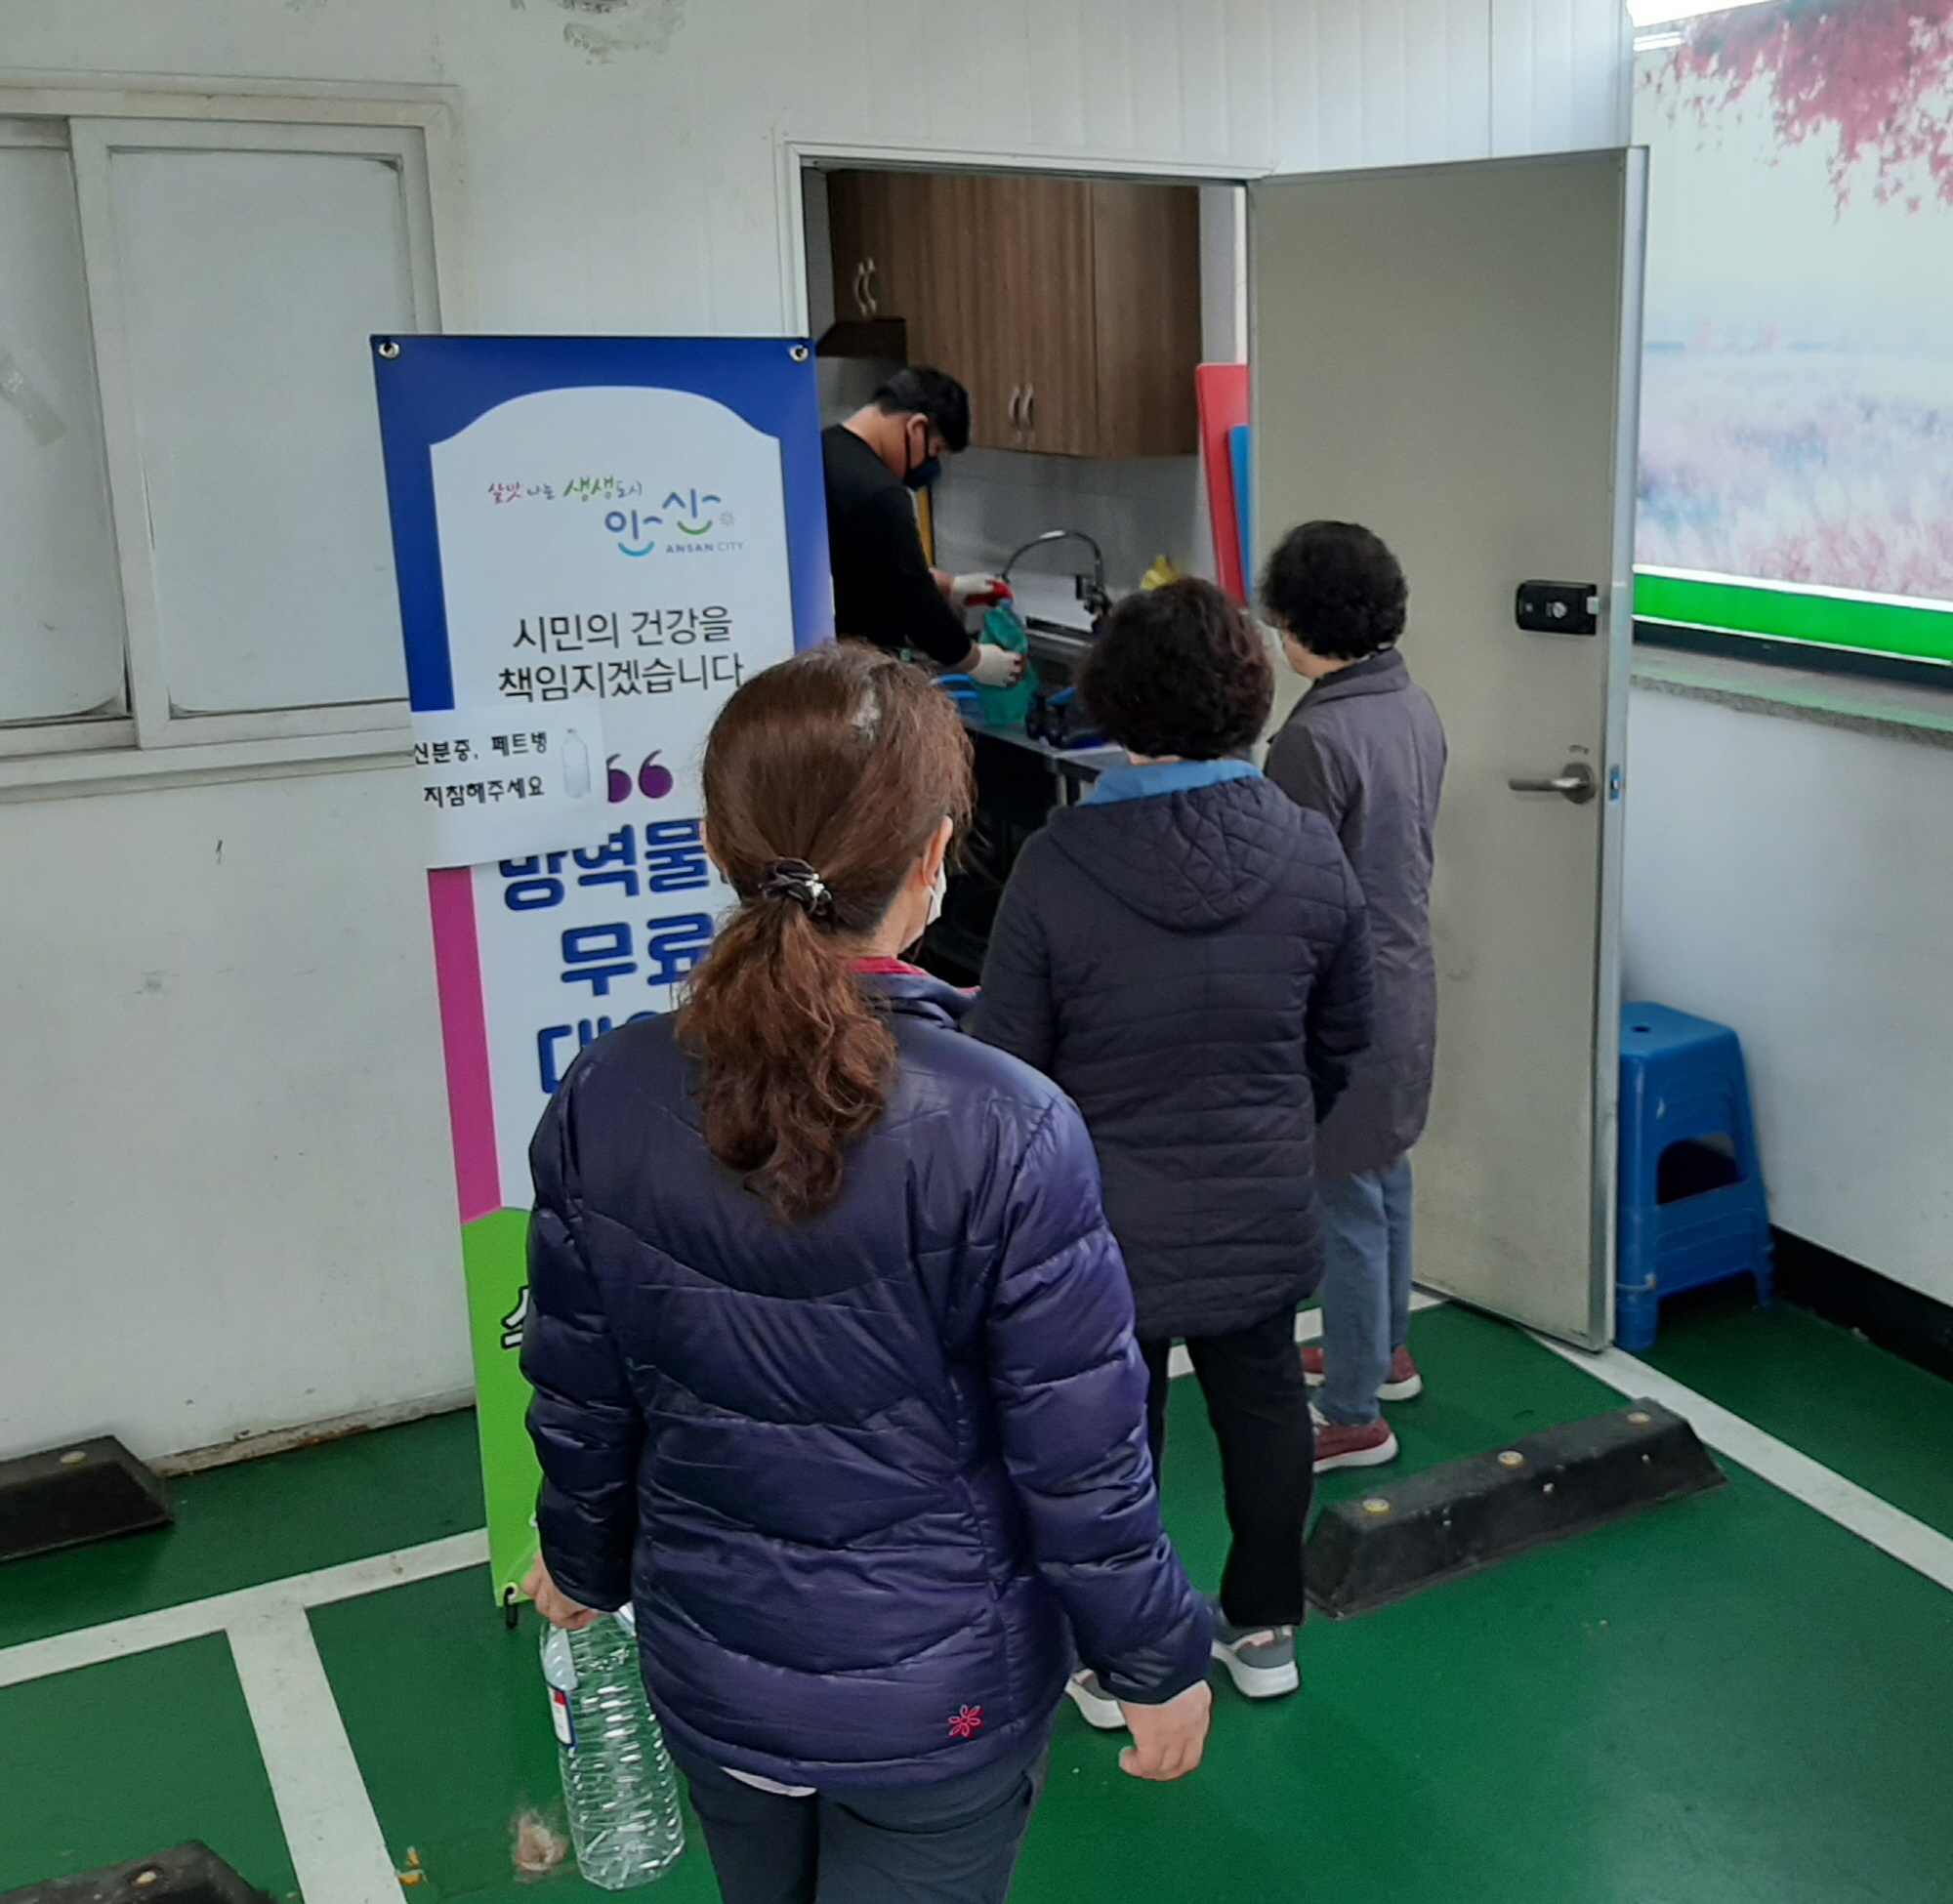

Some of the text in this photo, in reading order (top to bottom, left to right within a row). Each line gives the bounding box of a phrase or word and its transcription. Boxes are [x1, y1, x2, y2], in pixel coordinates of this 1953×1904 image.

[665, 540, 744, 555] ANSAN CITY
[512, 605, 732, 653] 시민의 건강을
[498, 651, 745, 703] 책임지겠습니다
[491, 731, 547, 757] 페트병
[424, 775, 545, 808] 지참해주세요
[498, 817, 728, 912] 방역물
[561, 911, 715, 998] 무료
